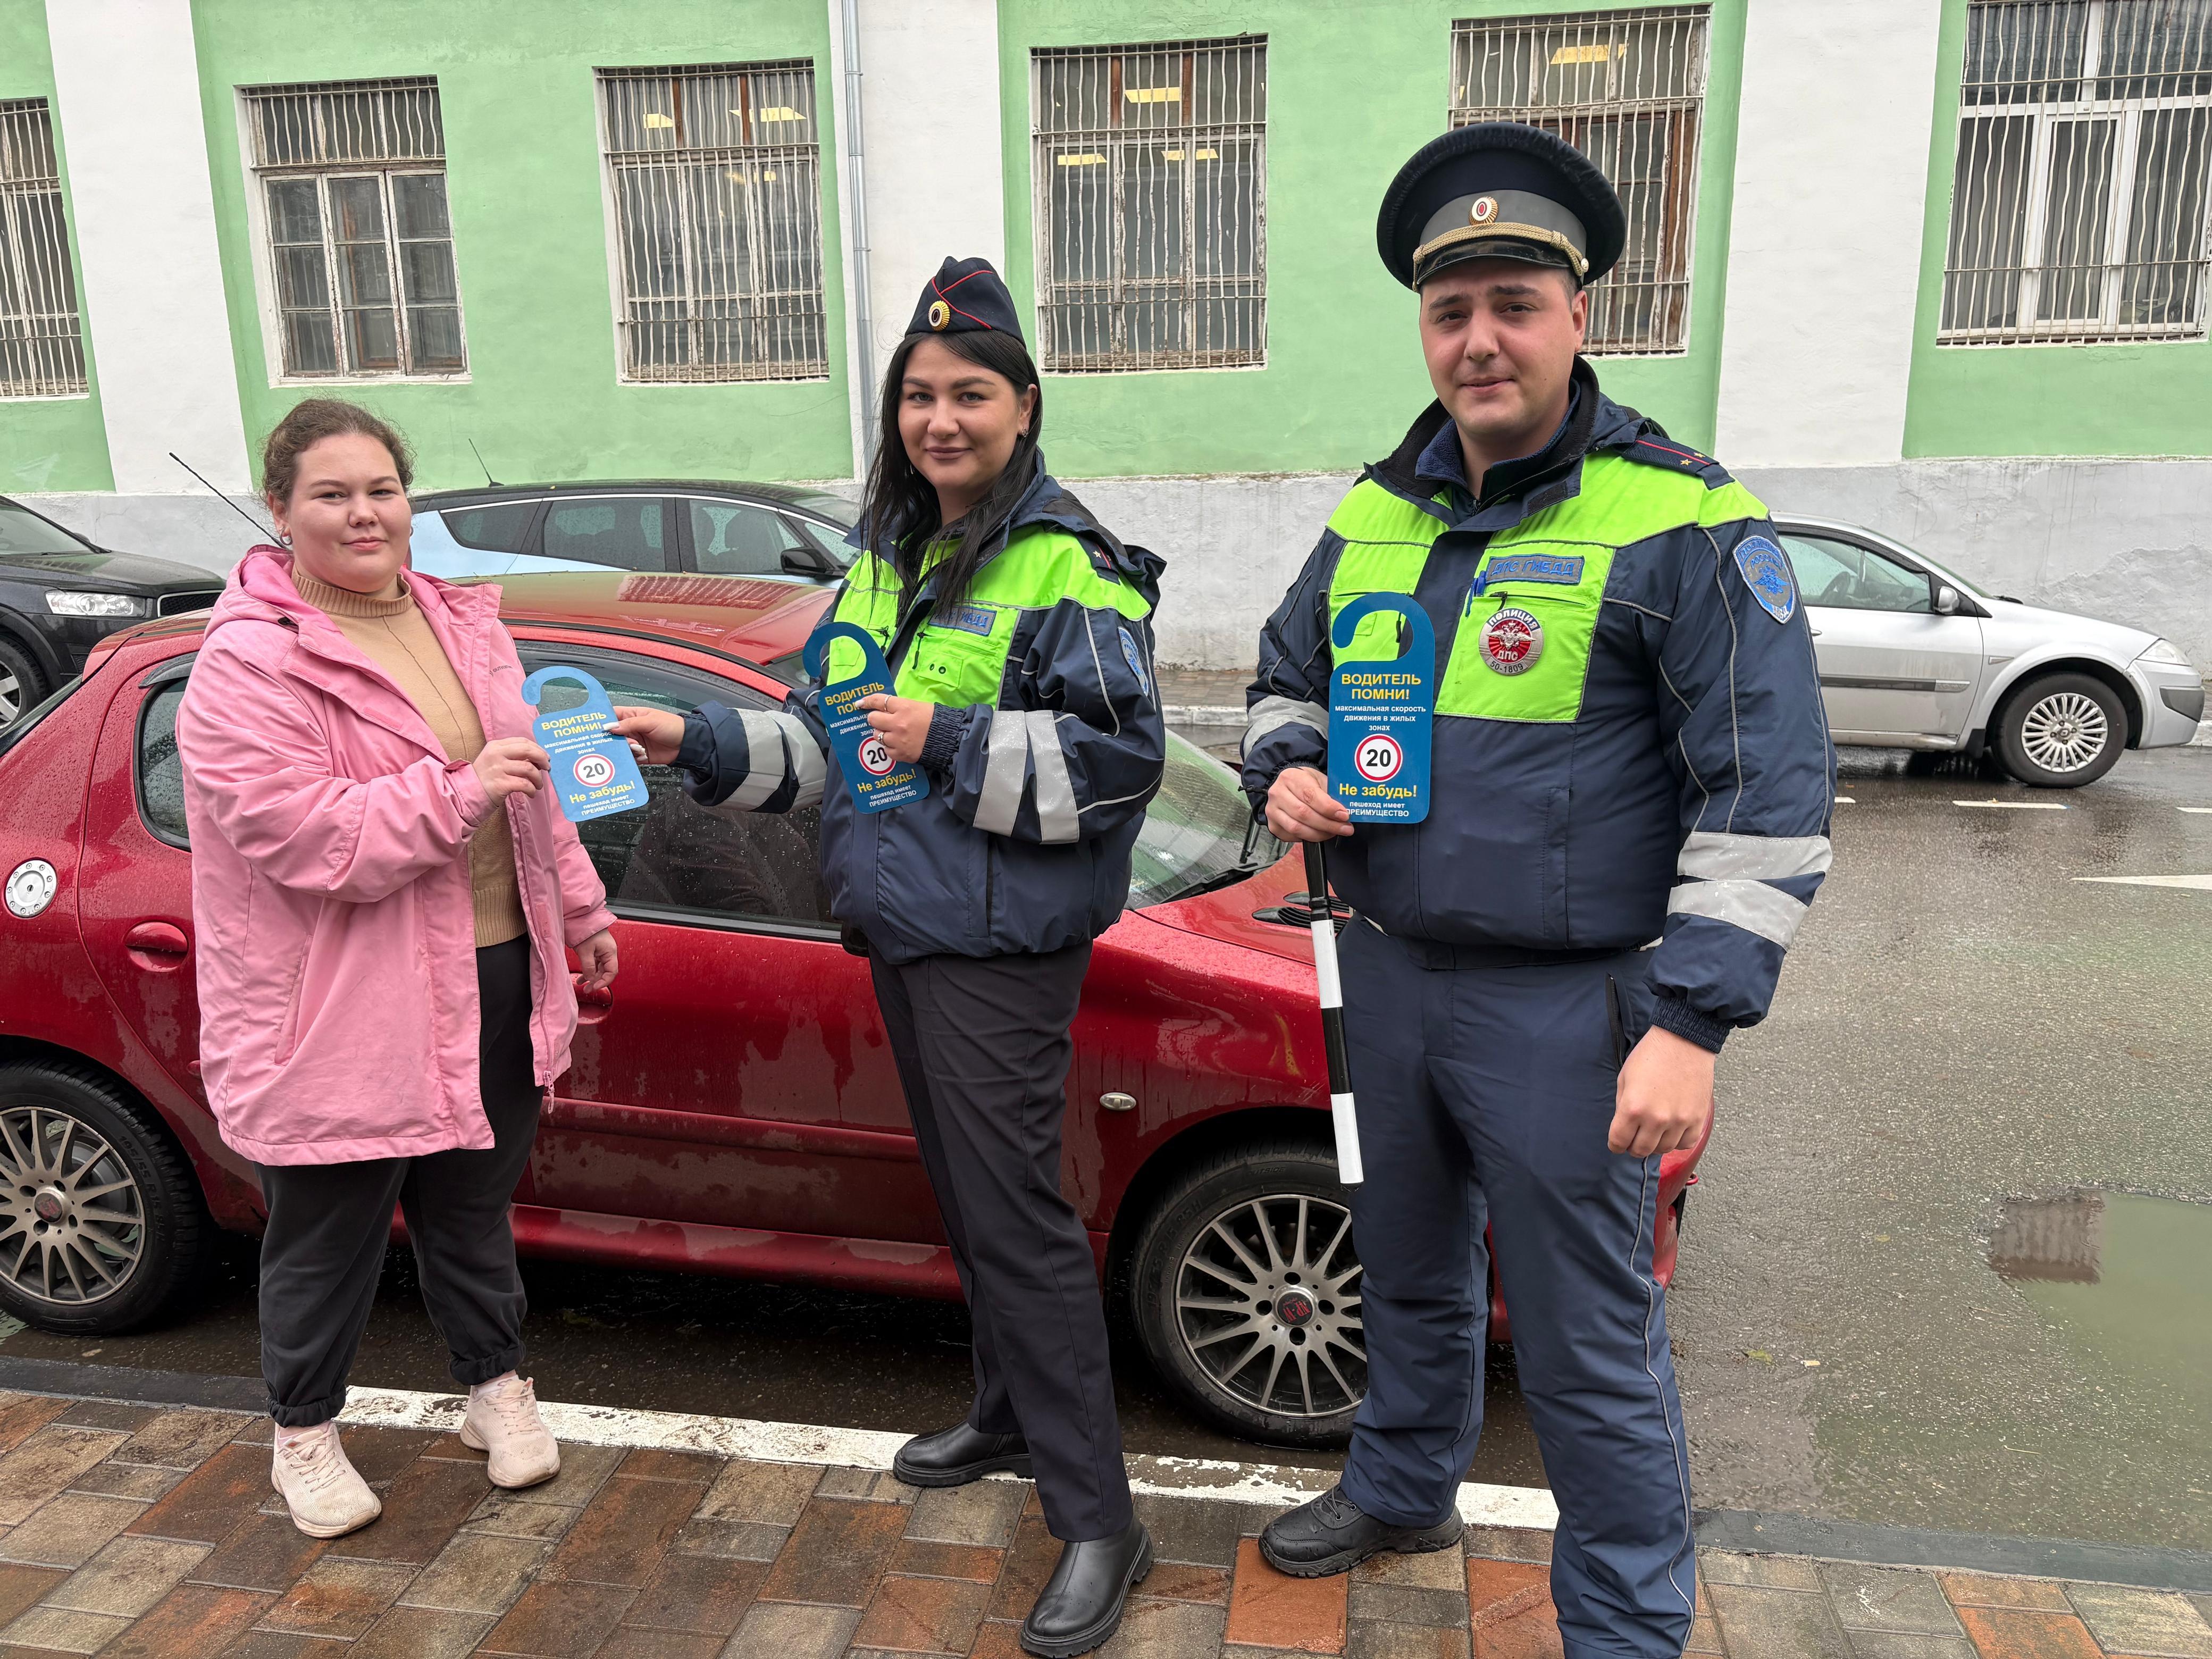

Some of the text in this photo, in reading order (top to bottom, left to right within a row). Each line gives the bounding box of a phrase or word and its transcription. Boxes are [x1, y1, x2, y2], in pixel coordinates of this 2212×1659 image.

[1491, 559, 1574, 576] ДПС ГИБДД
[1489, 609, 1538, 631] ПОЛИЦИЯ
[1497, 650, 1519, 661] ДПС
[1490, 661, 1523, 673] 50-1809
[1342, 674, 1421, 686] ВОДИТЕЛЬ
[825, 682, 885, 706] ВОДИТЕЛЬ
[1352, 689, 1409, 700] ПОМНИ!
[541, 712, 607, 731] ВОДИТЕЛЬ
[840, 722, 867, 735] движения
[554, 722, 602, 738] ПОМНИ!
[544, 735, 589, 749] максимальная
[555, 743, 585, 754] движения
[867, 747, 887, 765] 20
[1366, 749, 1391, 767] 20
[583, 763, 605, 778] 20
[857, 768, 916, 793] Не забудь!
[569, 780, 635, 803] Не забудь!
[869, 790, 917, 807] ПРЕИМУЩЕСТВО
[870, 790, 895, 800] пешеход
[1339, 783, 1418, 799] Не забудь!
[581, 799, 635, 816] ПРЕИМУЩЕСТВО
[583, 799, 610, 809] пешеход
